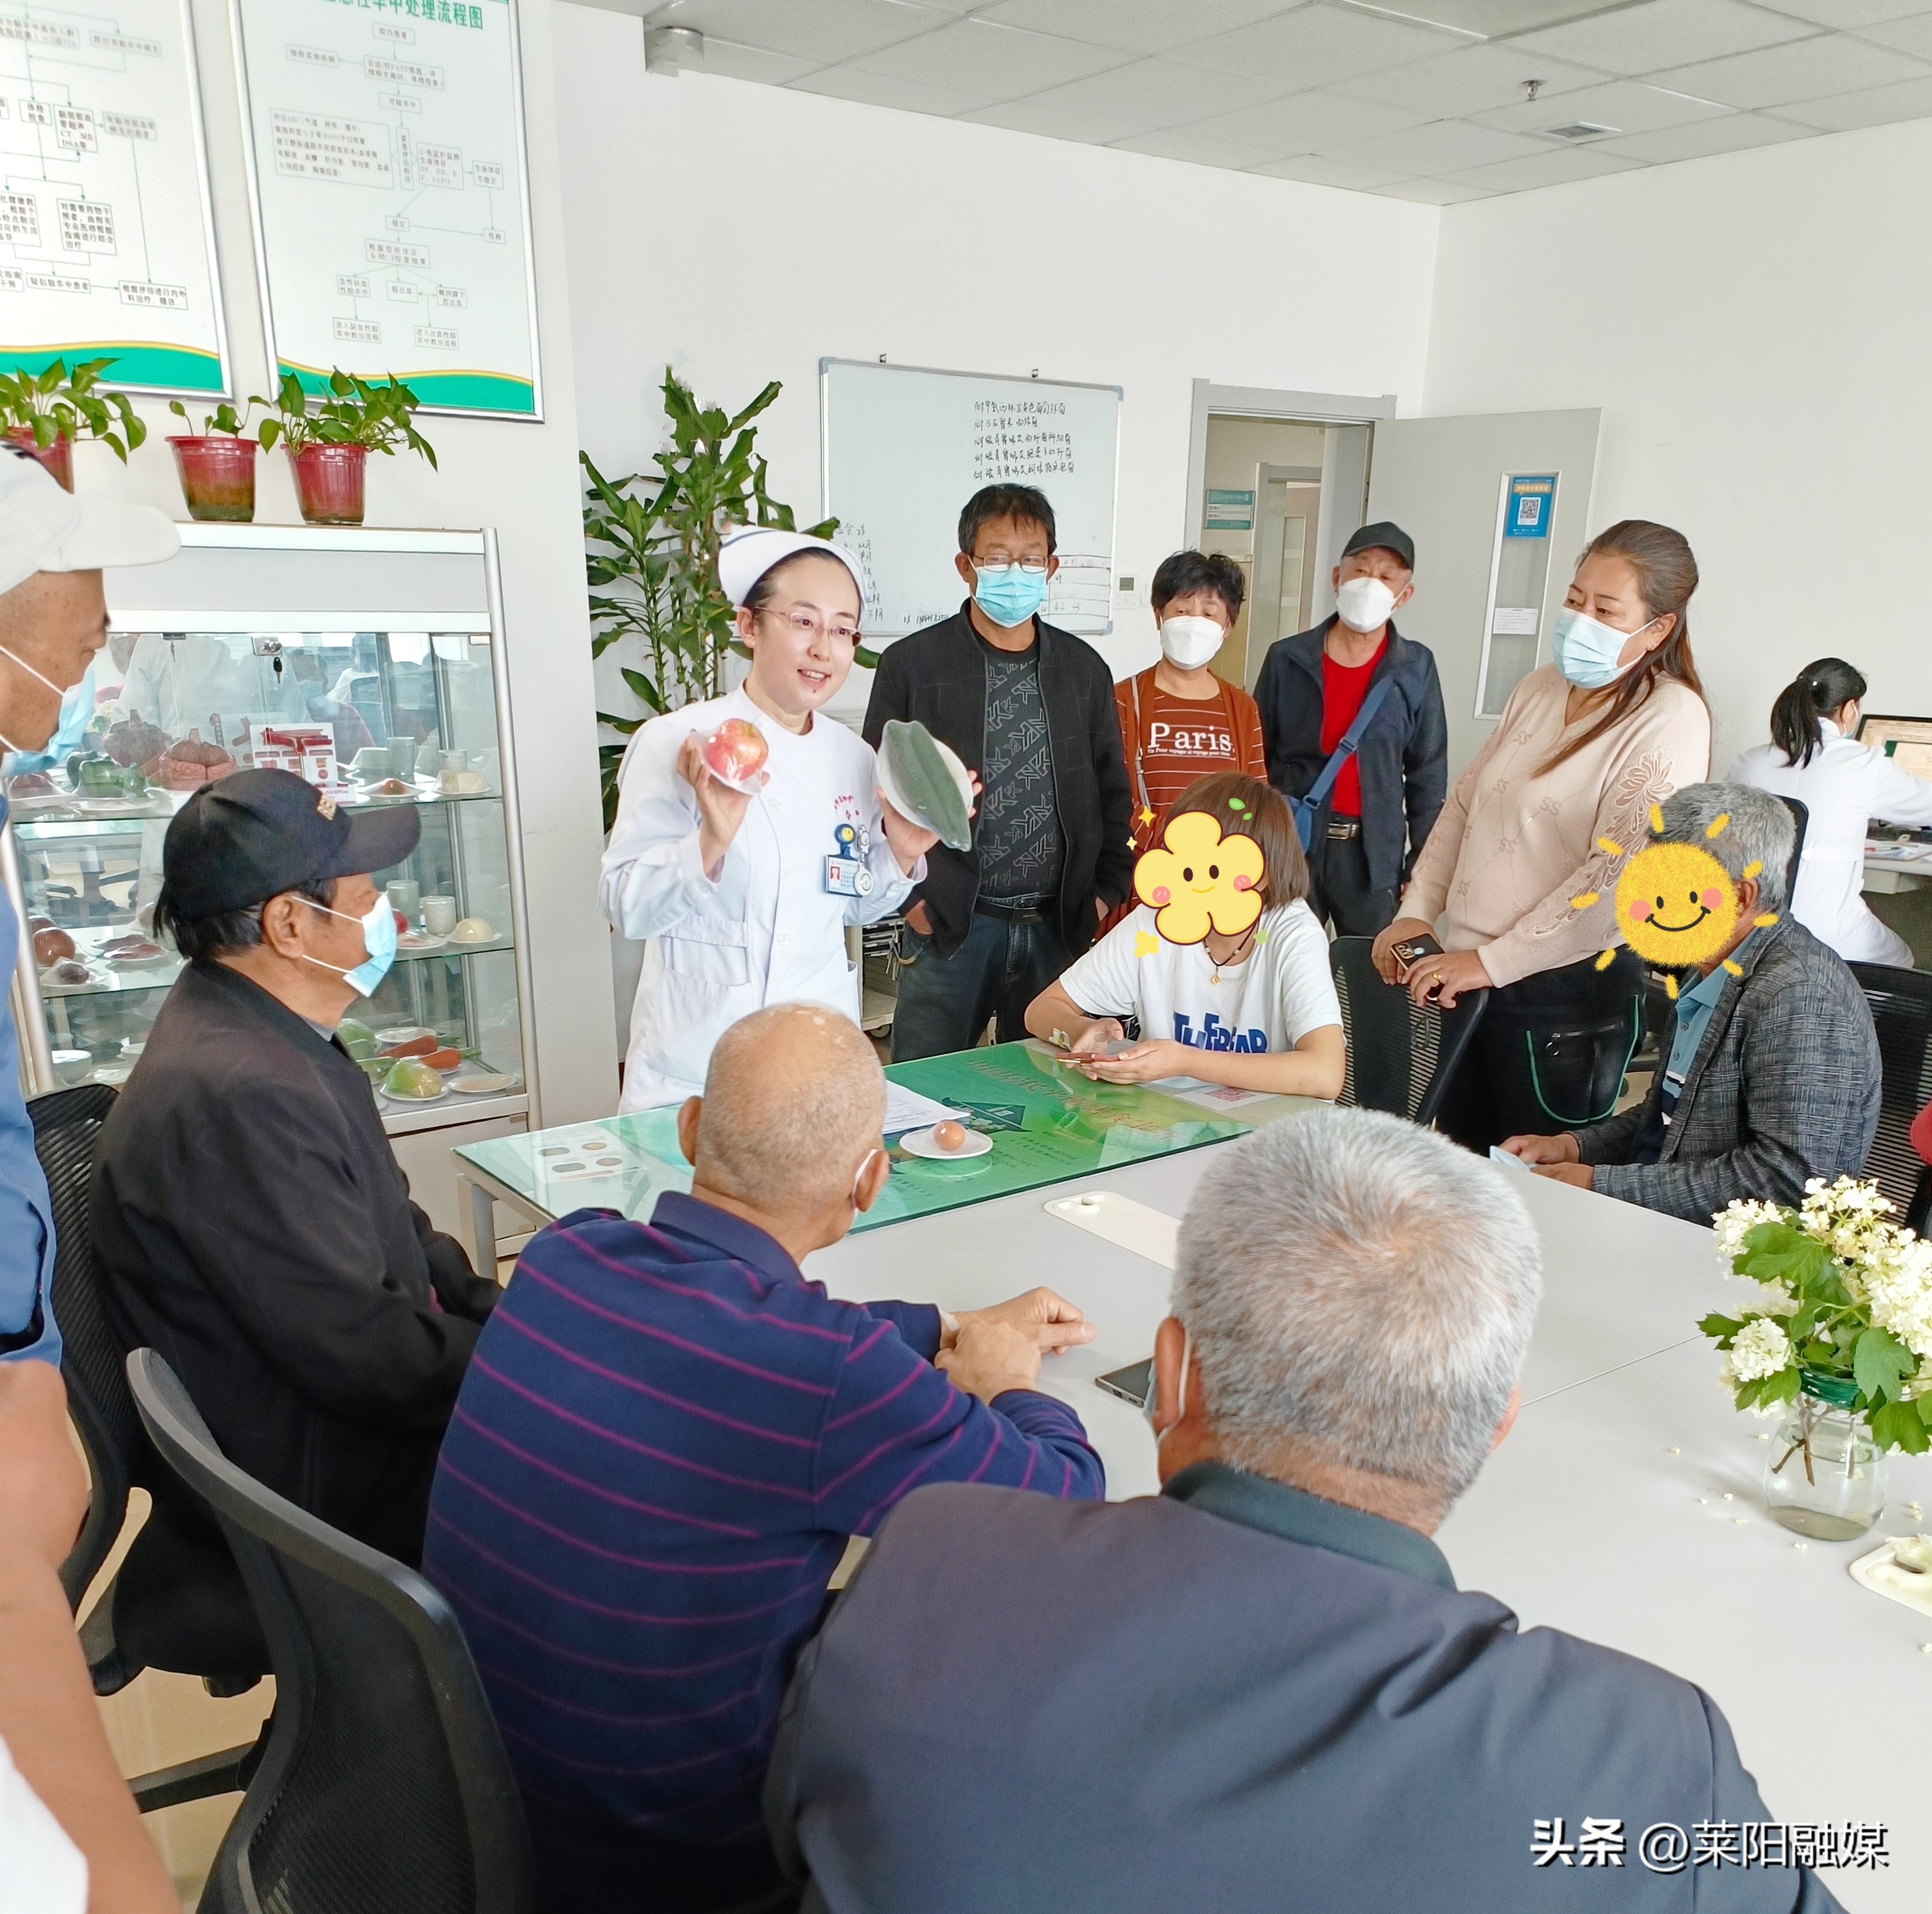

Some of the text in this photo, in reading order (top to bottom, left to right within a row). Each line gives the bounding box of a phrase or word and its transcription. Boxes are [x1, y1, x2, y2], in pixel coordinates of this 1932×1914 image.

[323, 0, 483, 29] 卒中处理流程图
[475, 165, 500, 175] 生命体征
[477, 176, 496, 185] 不稳定
[393, 219, 406, 229] 稳定
[65, 240, 81, 250] 治疗
[31, 277, 88, 291] 疑似脑卒中患者
[340, 278, 367, 287] 急性缺血
[340, 287, 368, 297] 性脑卒中
[392, 285, 412, 295] 脑出血
[336, 321, 378, 333] 进入缺血性脑
[336, 330, 379, 342] 卒中救治流程
[417, 329, 457, 339] 进入出血性脑
[417, 337, 457, 348] 卒中救治流程
[1148, 722, 1232, 752] Paris
